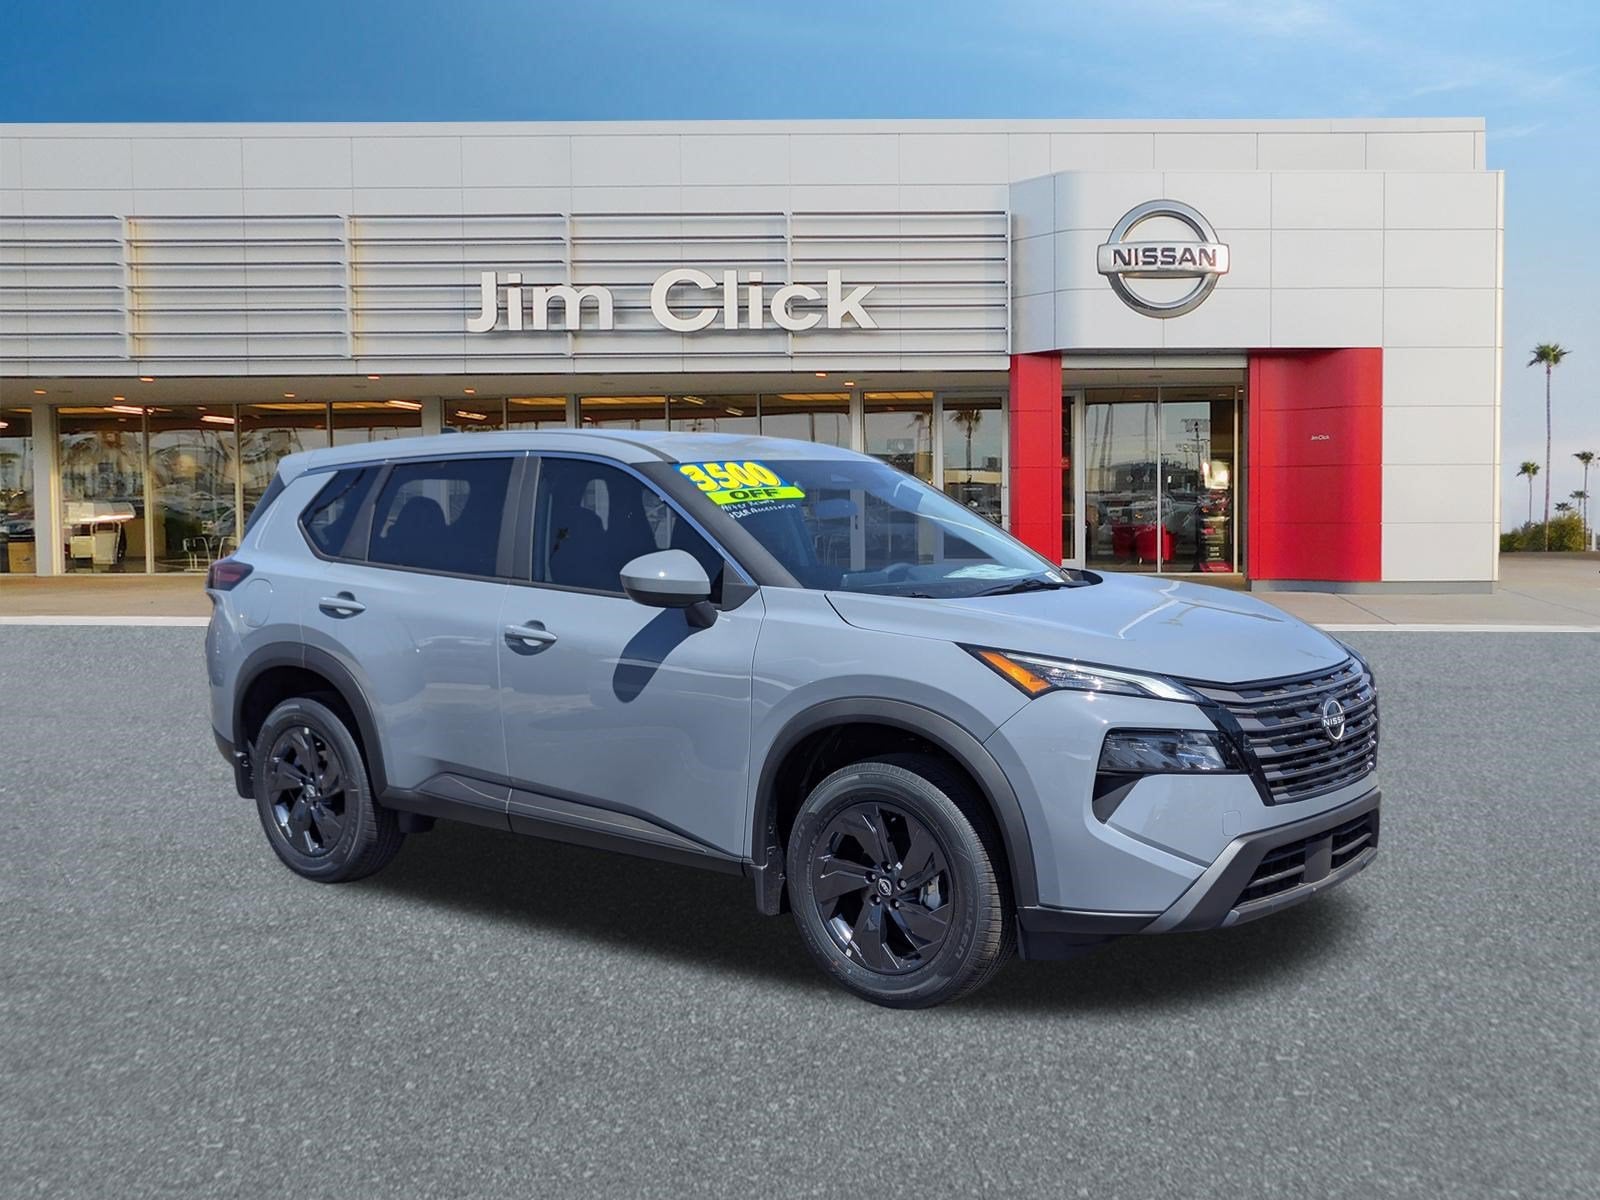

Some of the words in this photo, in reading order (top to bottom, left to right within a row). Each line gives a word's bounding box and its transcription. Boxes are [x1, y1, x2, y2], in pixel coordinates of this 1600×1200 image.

[1112, 247, 1217, 267] NISSAN
[466, 271, 615, 334] Jim
[650, 268, 879, 333] Click
[679, 462, 781, 491] 3500
[729, 489, 778, 500] OFF
[1323, 715, 1345, 726] NISS
